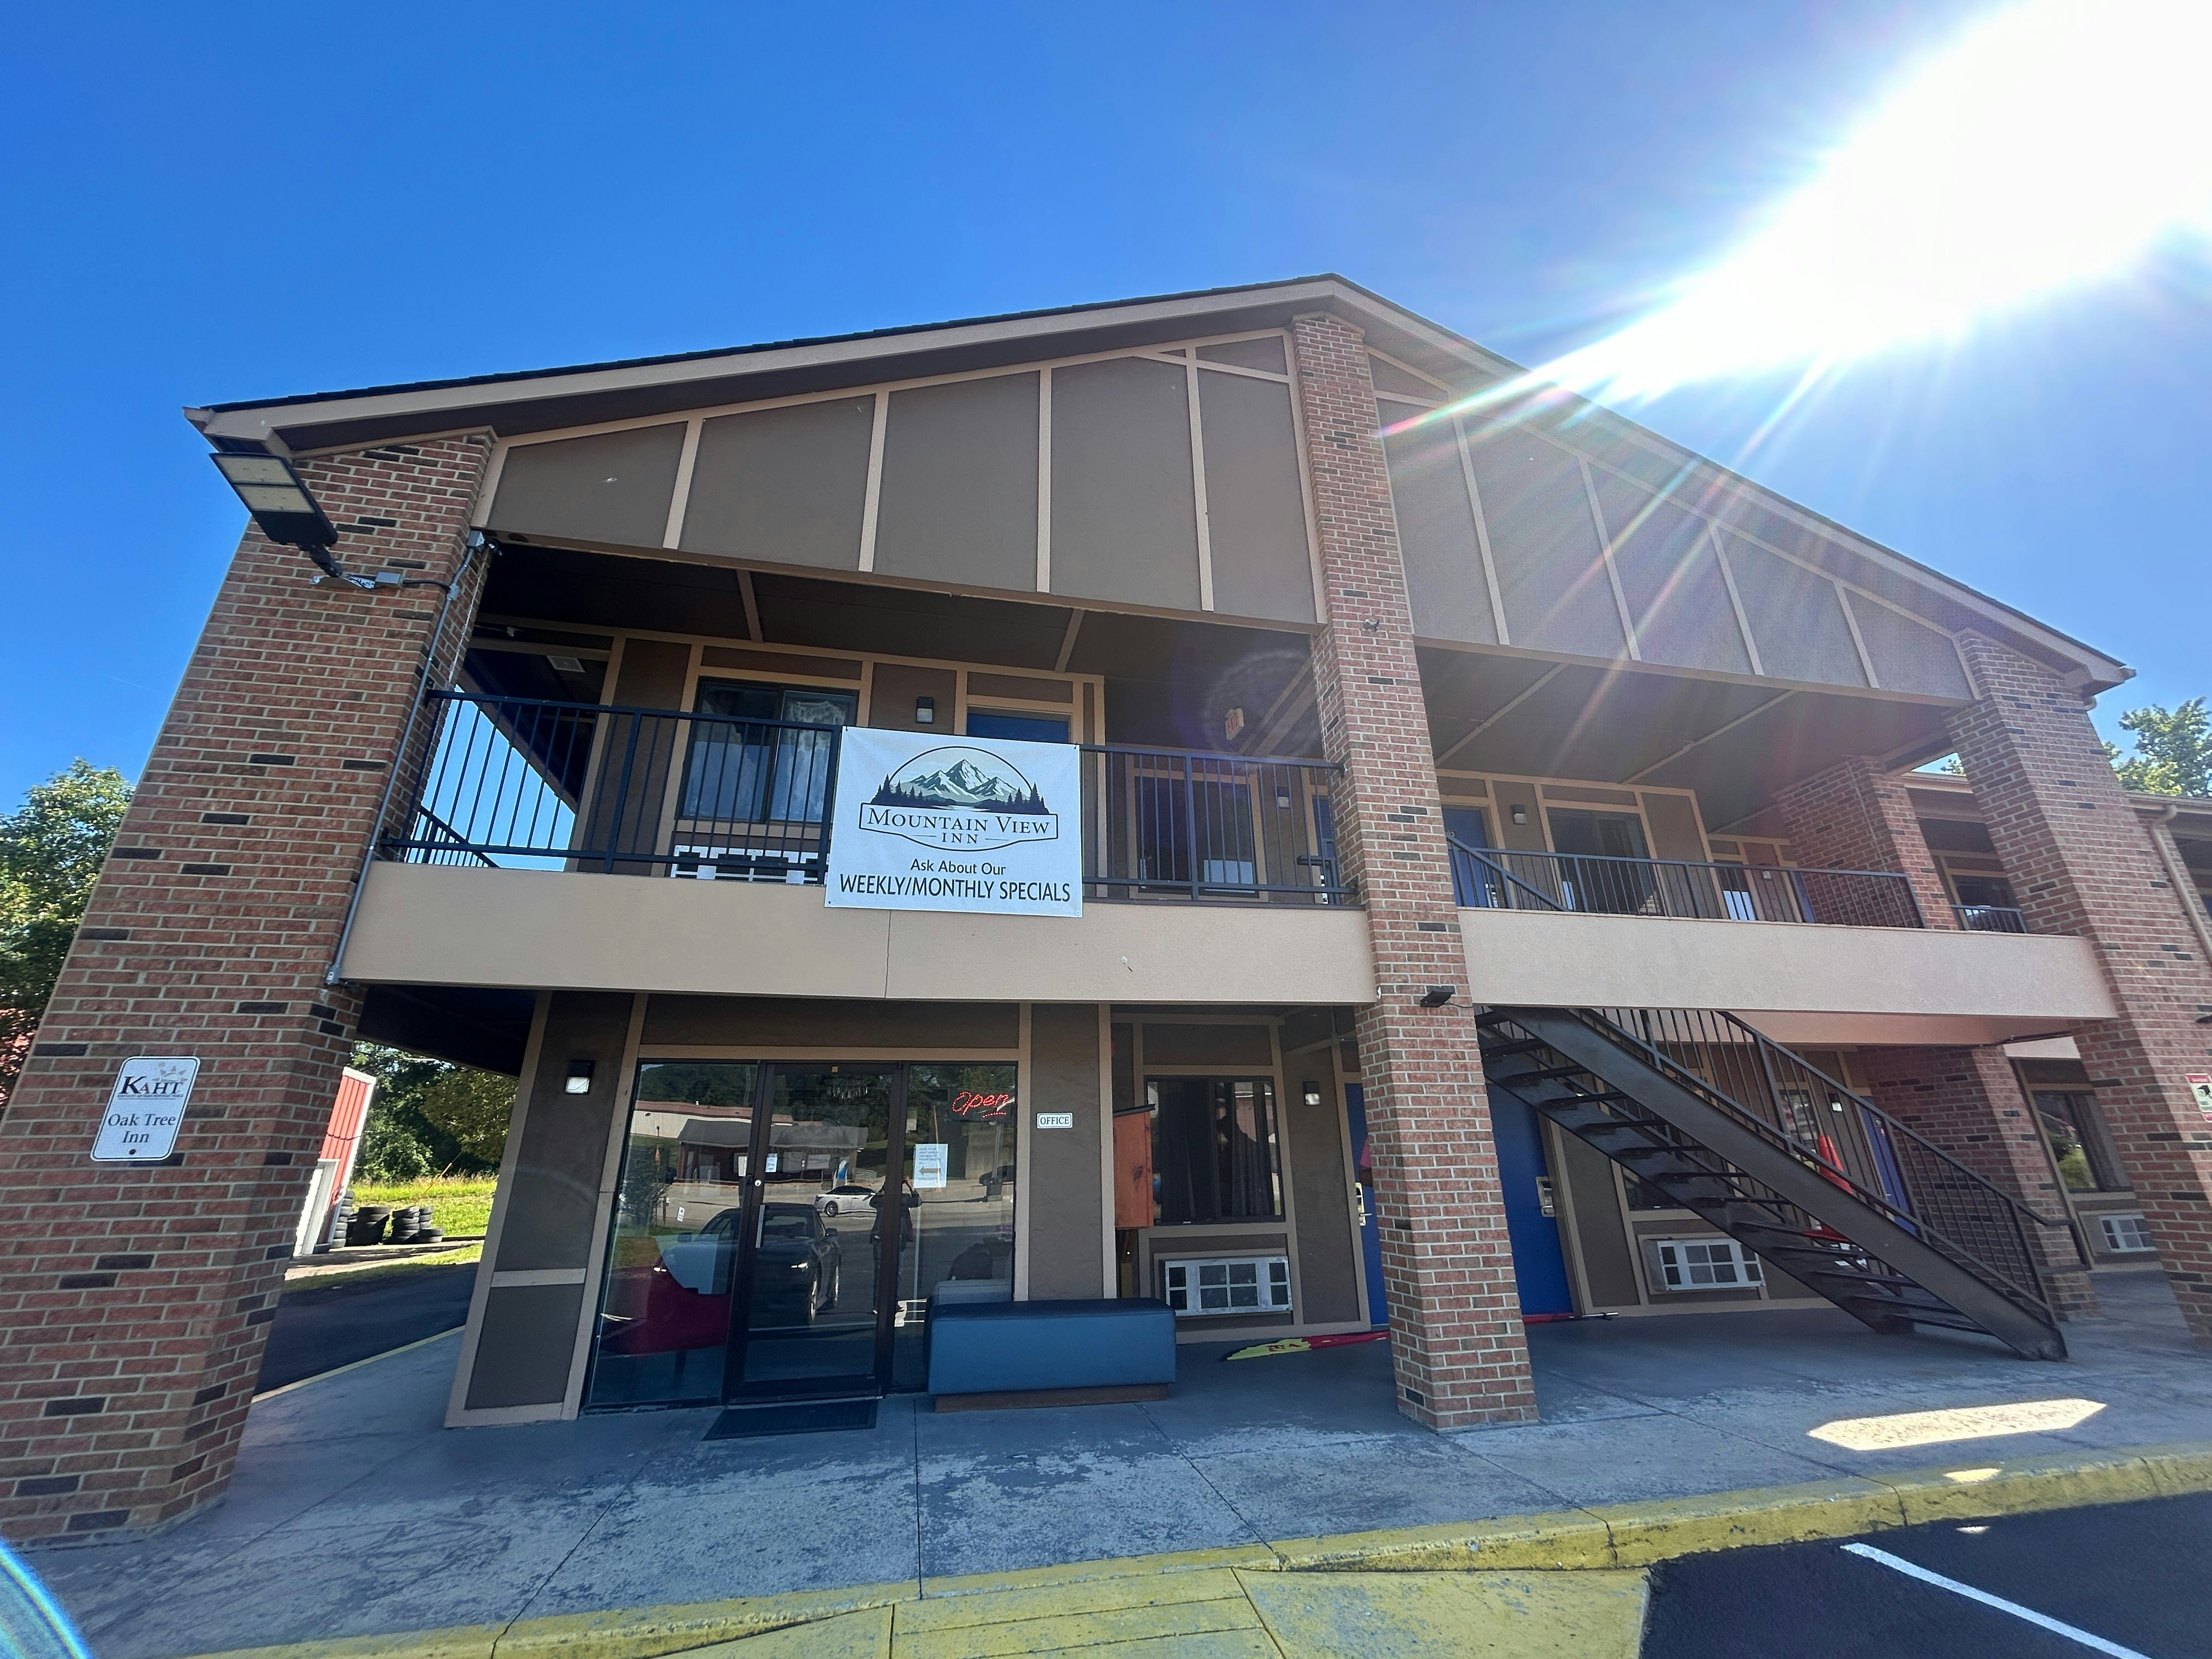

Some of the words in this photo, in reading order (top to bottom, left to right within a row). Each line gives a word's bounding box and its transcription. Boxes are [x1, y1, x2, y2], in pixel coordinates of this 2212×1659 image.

[941, 832, 979, 844] INN
[911, 859, 934, 872] Ask
[938, 860, 977, 874] About
[980, 862, 1006, 875] Our
[840, 874, 994, 898] WEEKLY/MONTHLY
[1000, 882, 1070, 901] SPECIALS
[952, 1091, 1008, 1115] Open
[108, 1114, 139, 1126] Oak
[144, 1113, 176, 1126] Tree
[1040, 1116, 1069, 1125] OFFICE
[122, 1131, 149, 1143] Inn
